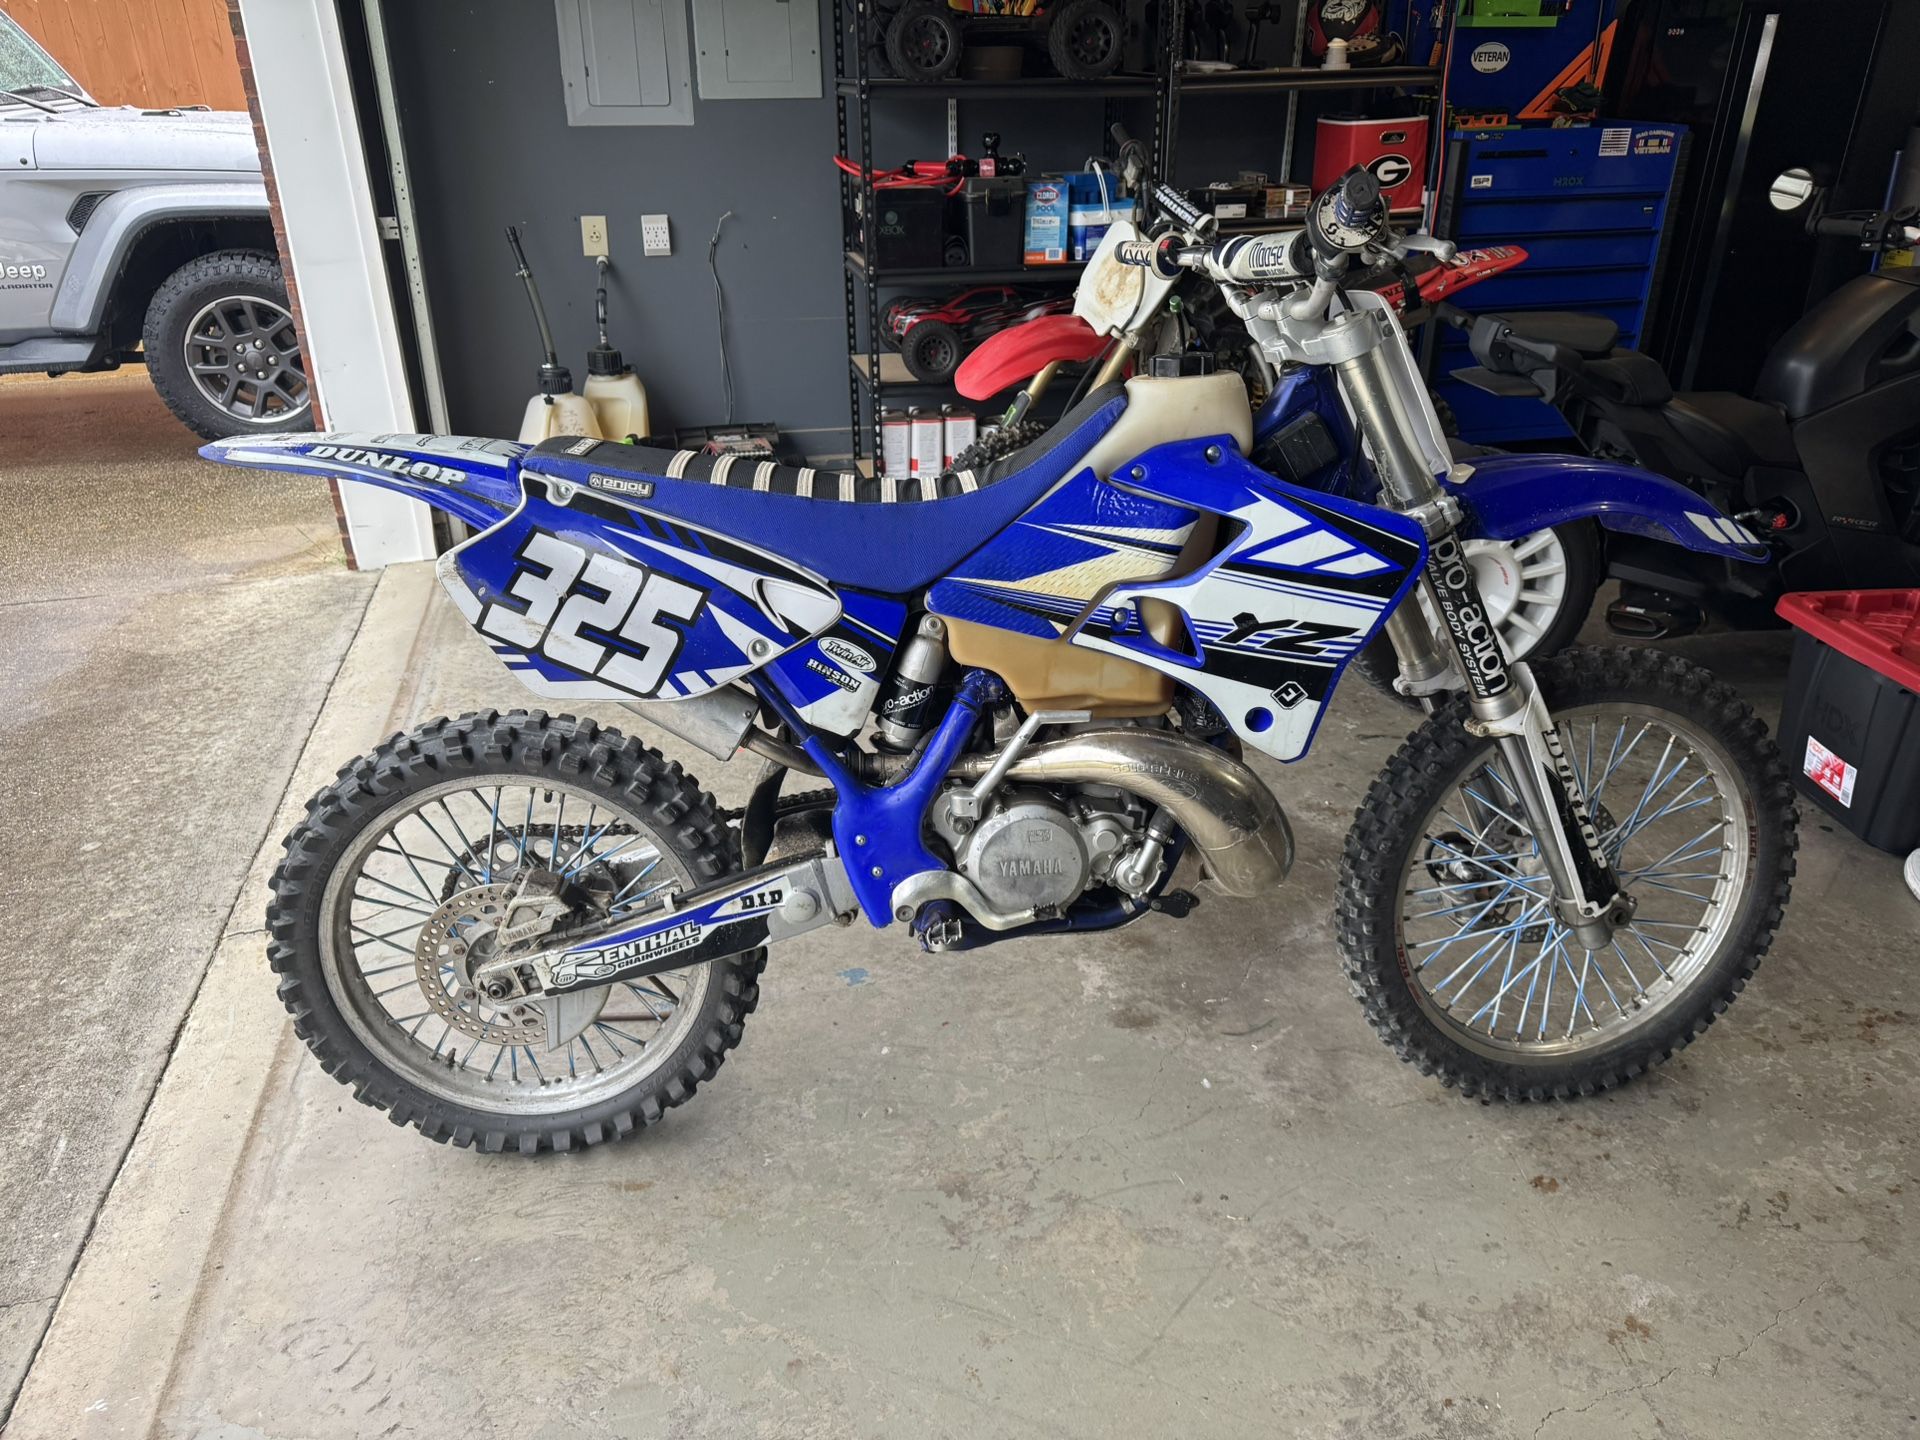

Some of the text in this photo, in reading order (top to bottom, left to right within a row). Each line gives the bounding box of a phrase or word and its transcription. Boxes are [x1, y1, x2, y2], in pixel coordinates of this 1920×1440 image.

[1472, 51, 1509, 63] VETERAN
[1036, 191, 1058, 200] CLOROX
[1036, 204, 1057, 213] POOL
[1154, 188, 1197, 226] RENTHAL
[1250, 242, 1284, 268] Moose
[306, 445, 466, 485] DUNLOP
[478, 527, 709, 697] 325
[1427, 555, 1489, 697] VALVE BODY SYSTEM
[1218, 611, 1361, 656] YZ
[806, 658, 862, 690] HINSON
[1542, 729, 1608, 870] DUNLOP
[1749, 825, 1757, 861] EXCEL
[999, 859, 1063, 878] YAMAHA
[740, 889, 784, 912] D.I.D
[551, 920, 703, 987] RENTHAL
[616, 936, 701, 970] CHAINWHEELS
